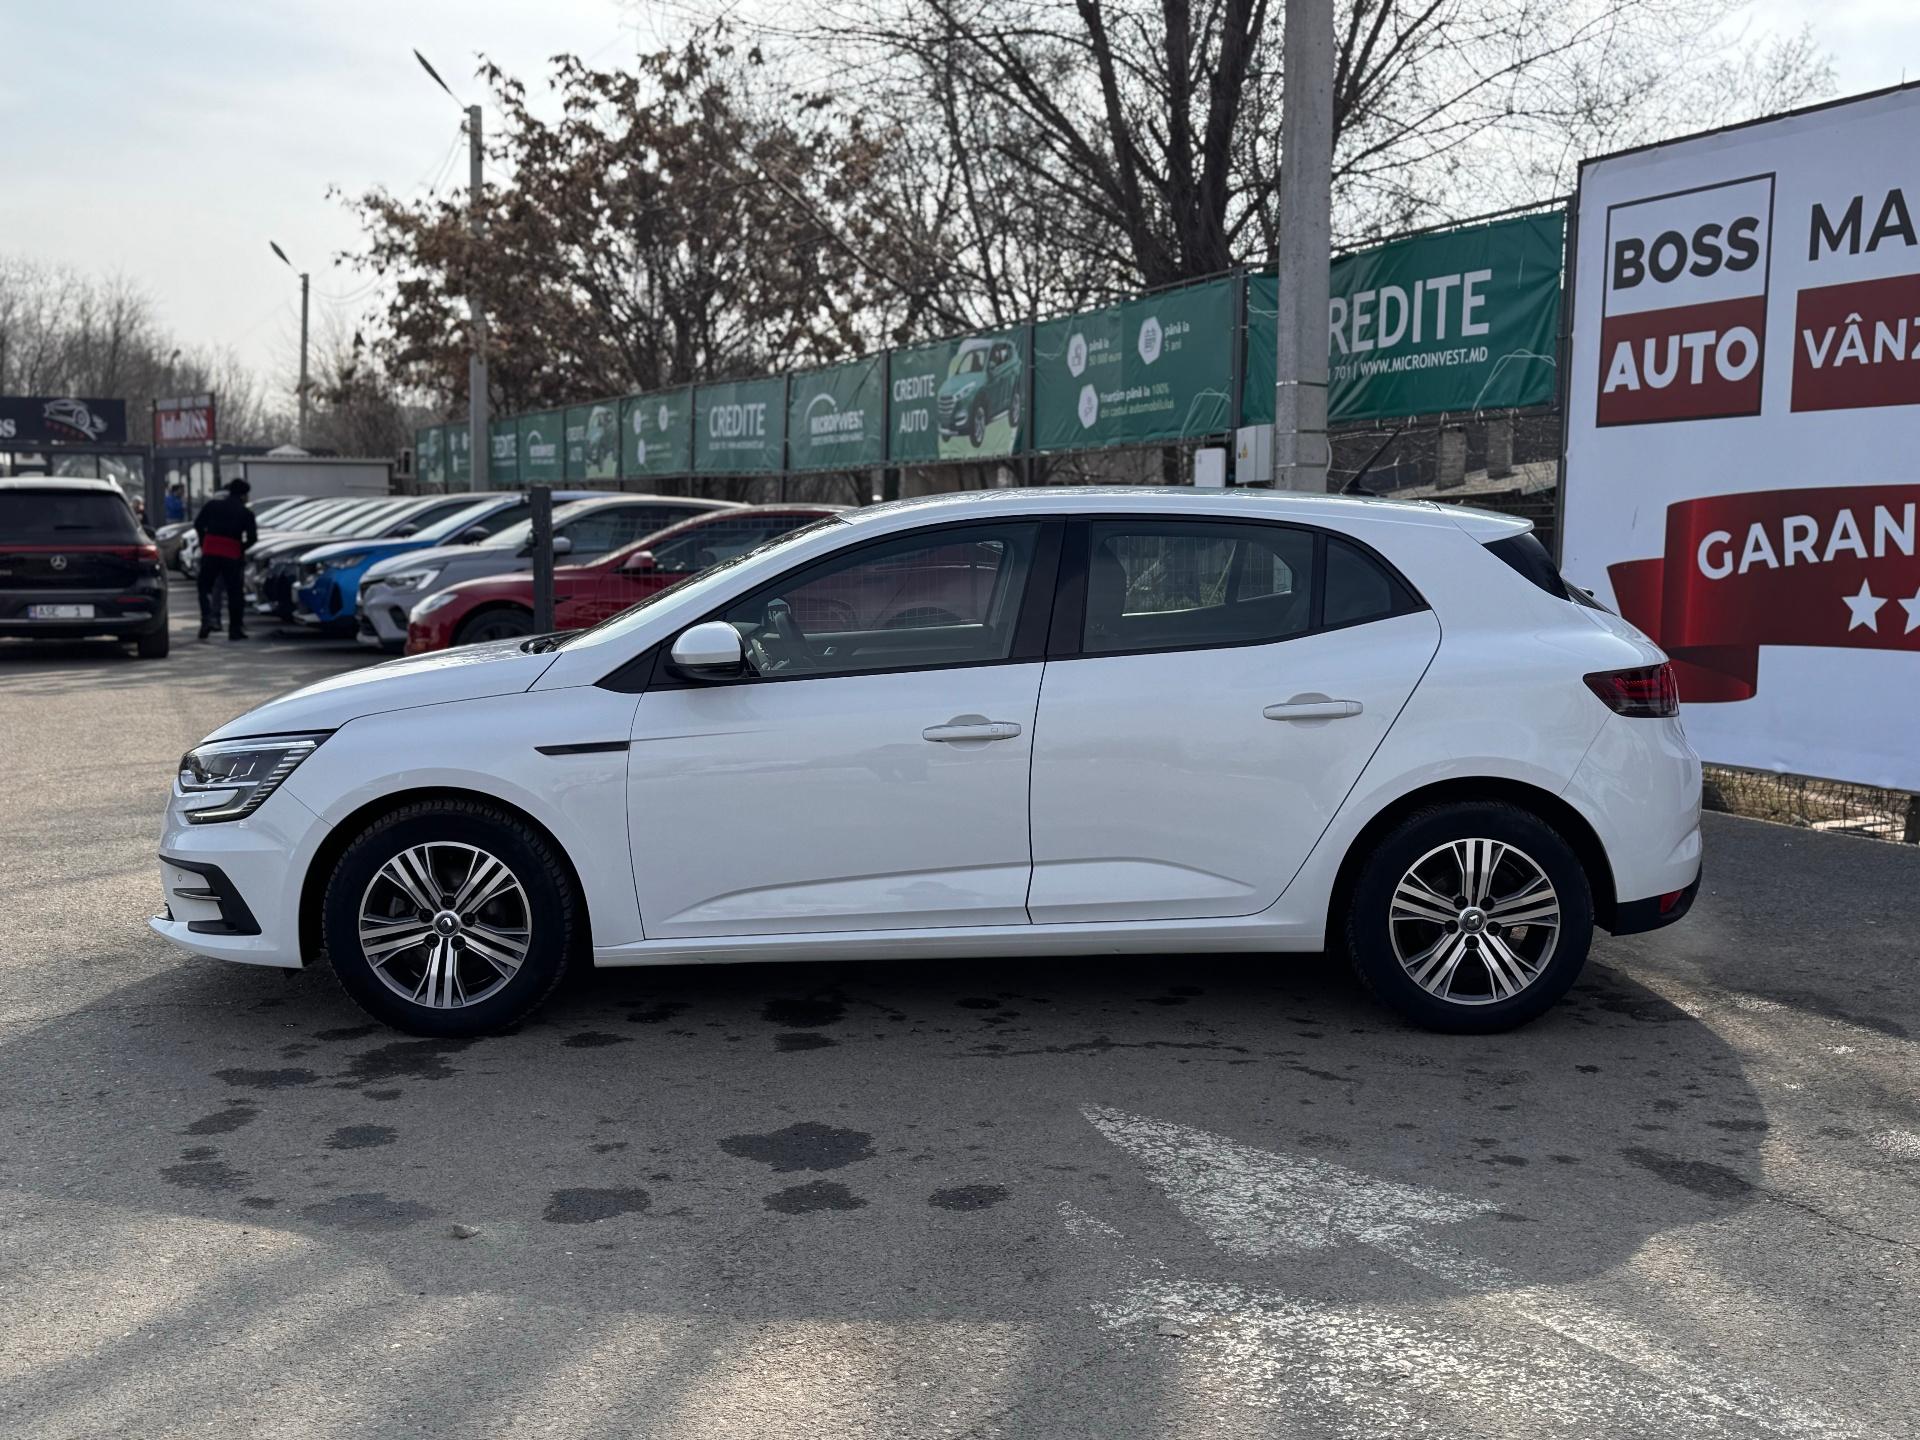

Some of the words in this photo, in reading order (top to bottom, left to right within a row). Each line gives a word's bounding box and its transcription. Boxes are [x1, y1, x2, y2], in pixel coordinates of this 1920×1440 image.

[1808, 188, 1918, 262] MA
[1612, 216, 1760, 290] BOSS
[1328, 268, 1493, 358] REDITE
[1360, 346, 1488, 377] WWW.MICROINVEST.MD
[1603, 326, 1759, 393] AUTO
[893, 374, 935, 402] CREDITE
[0, 418, 16, 438] S
[709, 403, 767, 437] CREDITE
[899, 409, 929, 434] AUTO
[1697, 503, 1916, 580] GARAN
